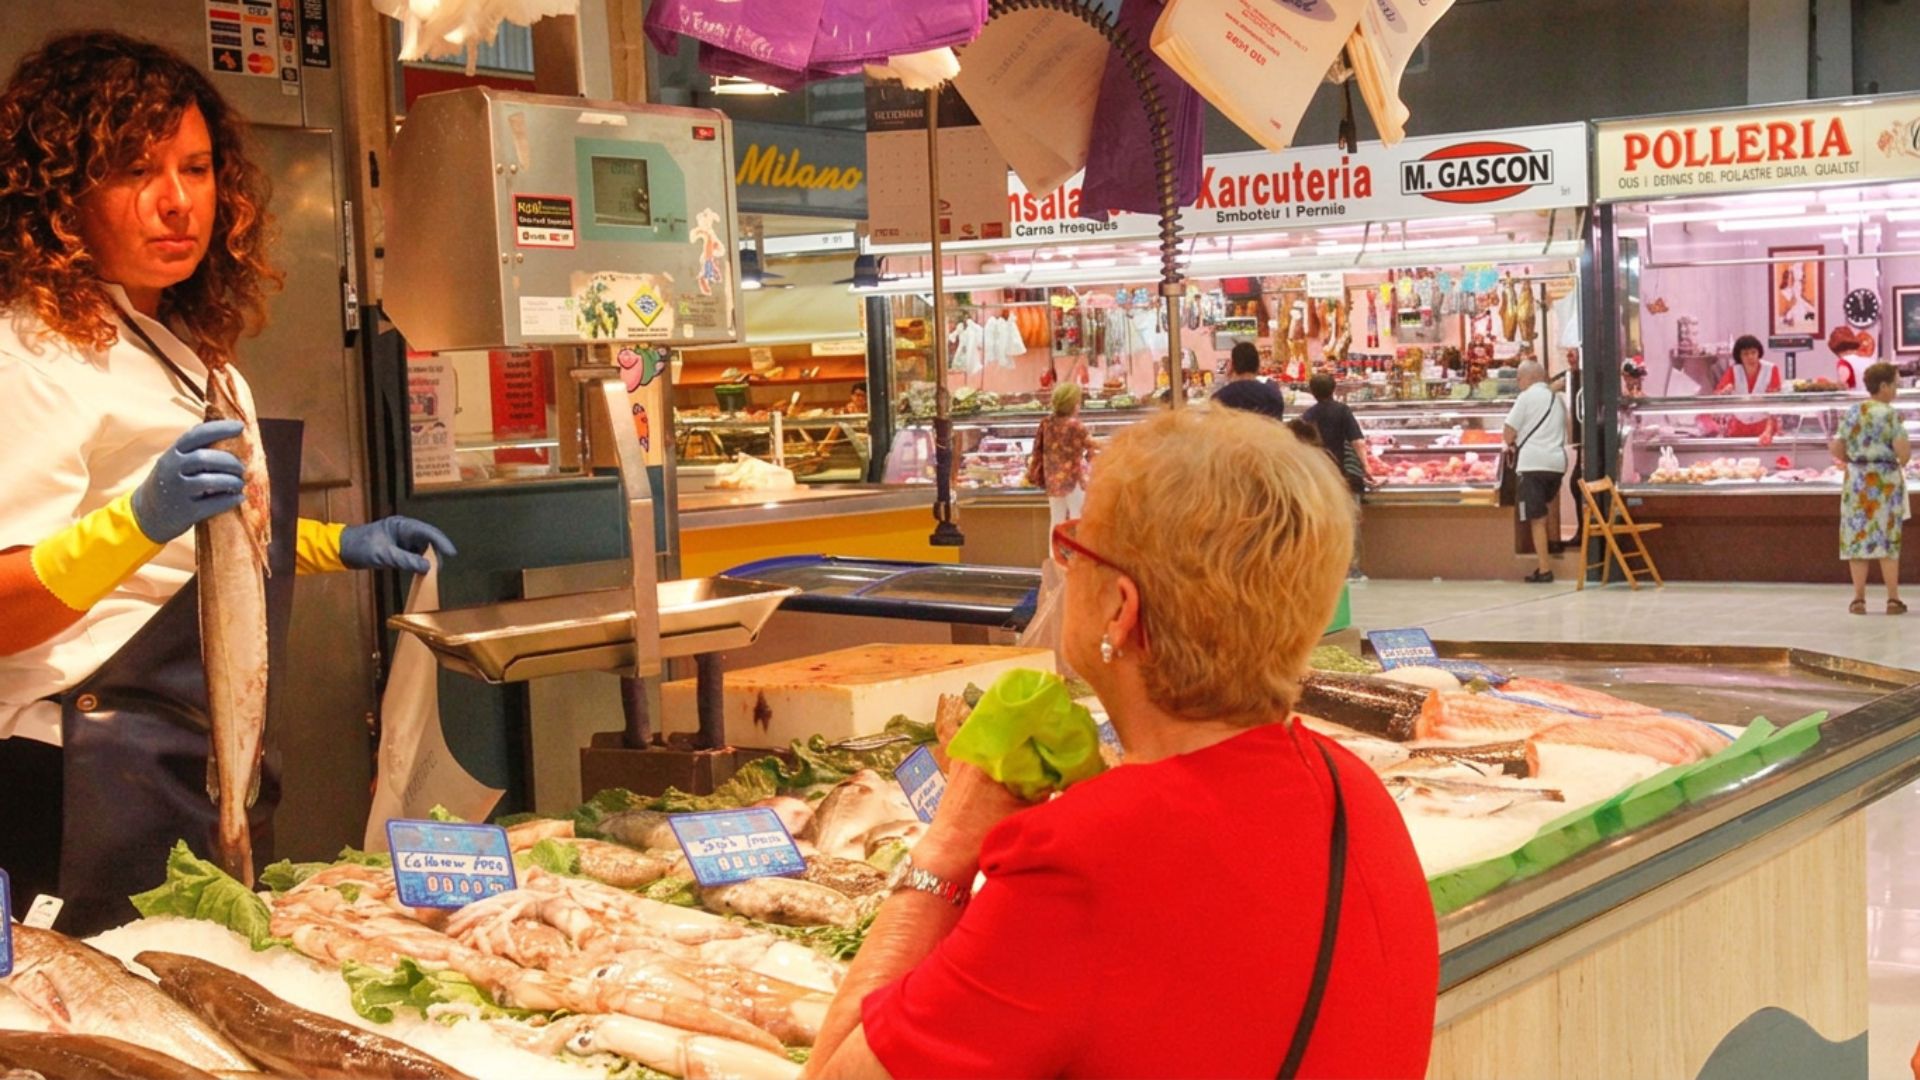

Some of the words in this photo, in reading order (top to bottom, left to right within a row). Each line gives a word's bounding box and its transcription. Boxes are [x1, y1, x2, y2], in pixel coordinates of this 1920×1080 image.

[1623, 116, 1852, 171] POLLERIA
[735, 143, 863, 192] Milano
[1404, 164, 1433, 191] M.
[1438, 153, 1550, 189] GASCON
[1015, 224, 1055, 237] Carns
